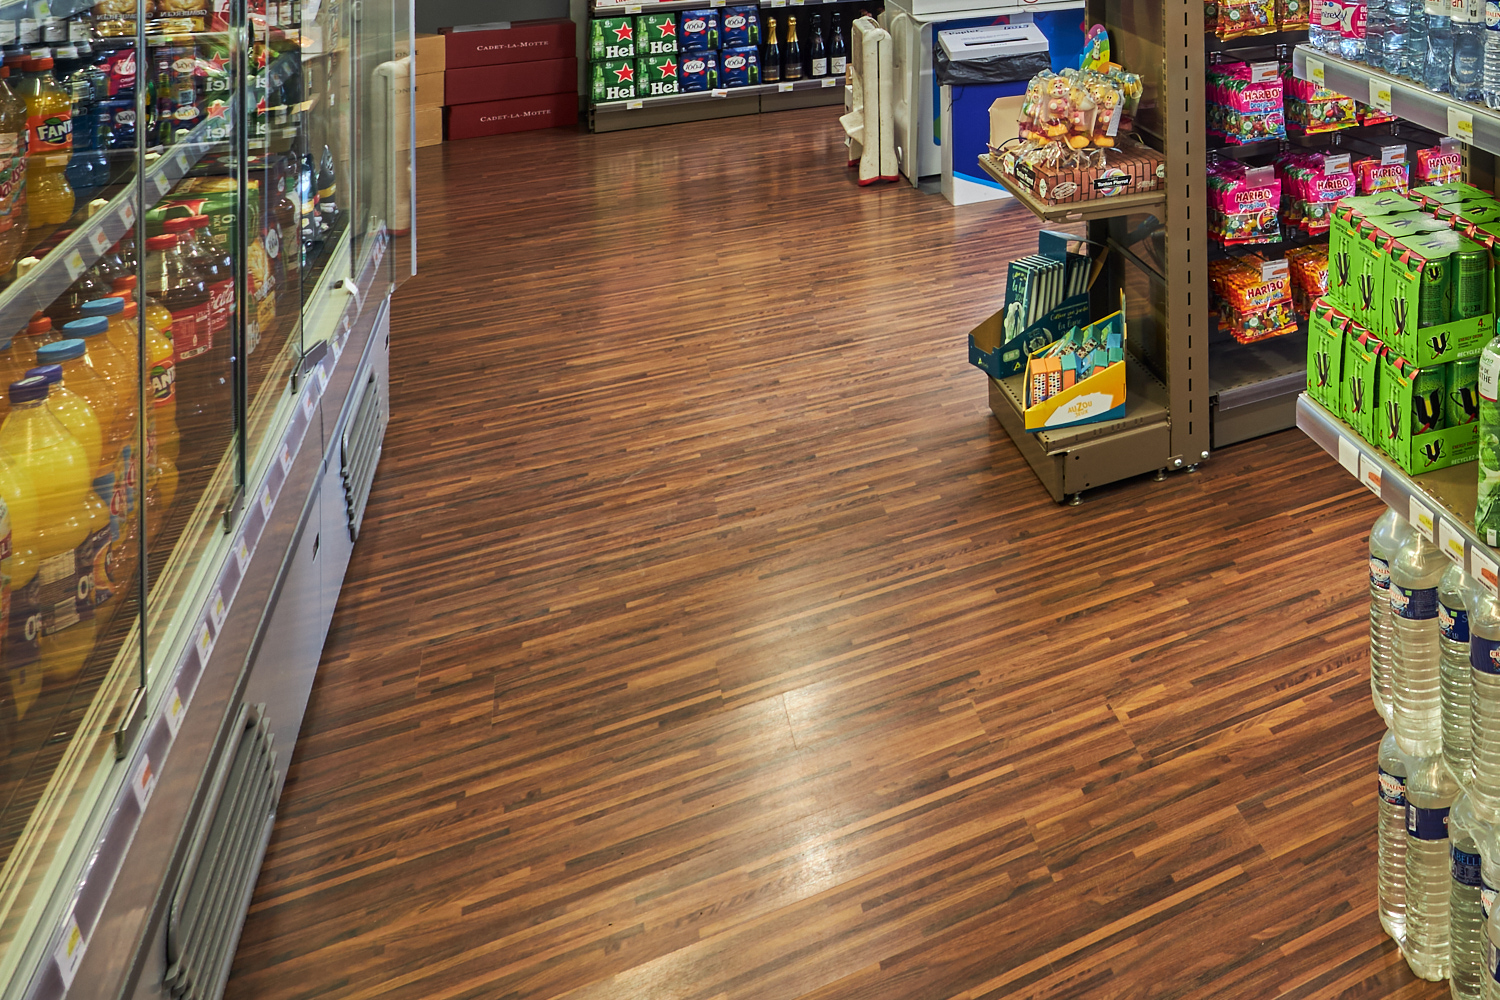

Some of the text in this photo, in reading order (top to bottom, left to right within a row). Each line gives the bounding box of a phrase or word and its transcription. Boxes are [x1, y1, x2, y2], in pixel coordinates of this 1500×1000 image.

[477, 41, 549, 51] CADET-LA-MOTTE
[606, 44, 634, 58] Hei
[650, 40, 678, 54] Hei
[1244, 89, 1279, 101] HARIBO
[480, 109, 551, 122] CADET-LA-MOTTE
[1317, 179, 1349, 190] HARIBO
[1236, 190, 1271, 202] HARIBO
[1068, 400, 1093, 415] AUZOU
